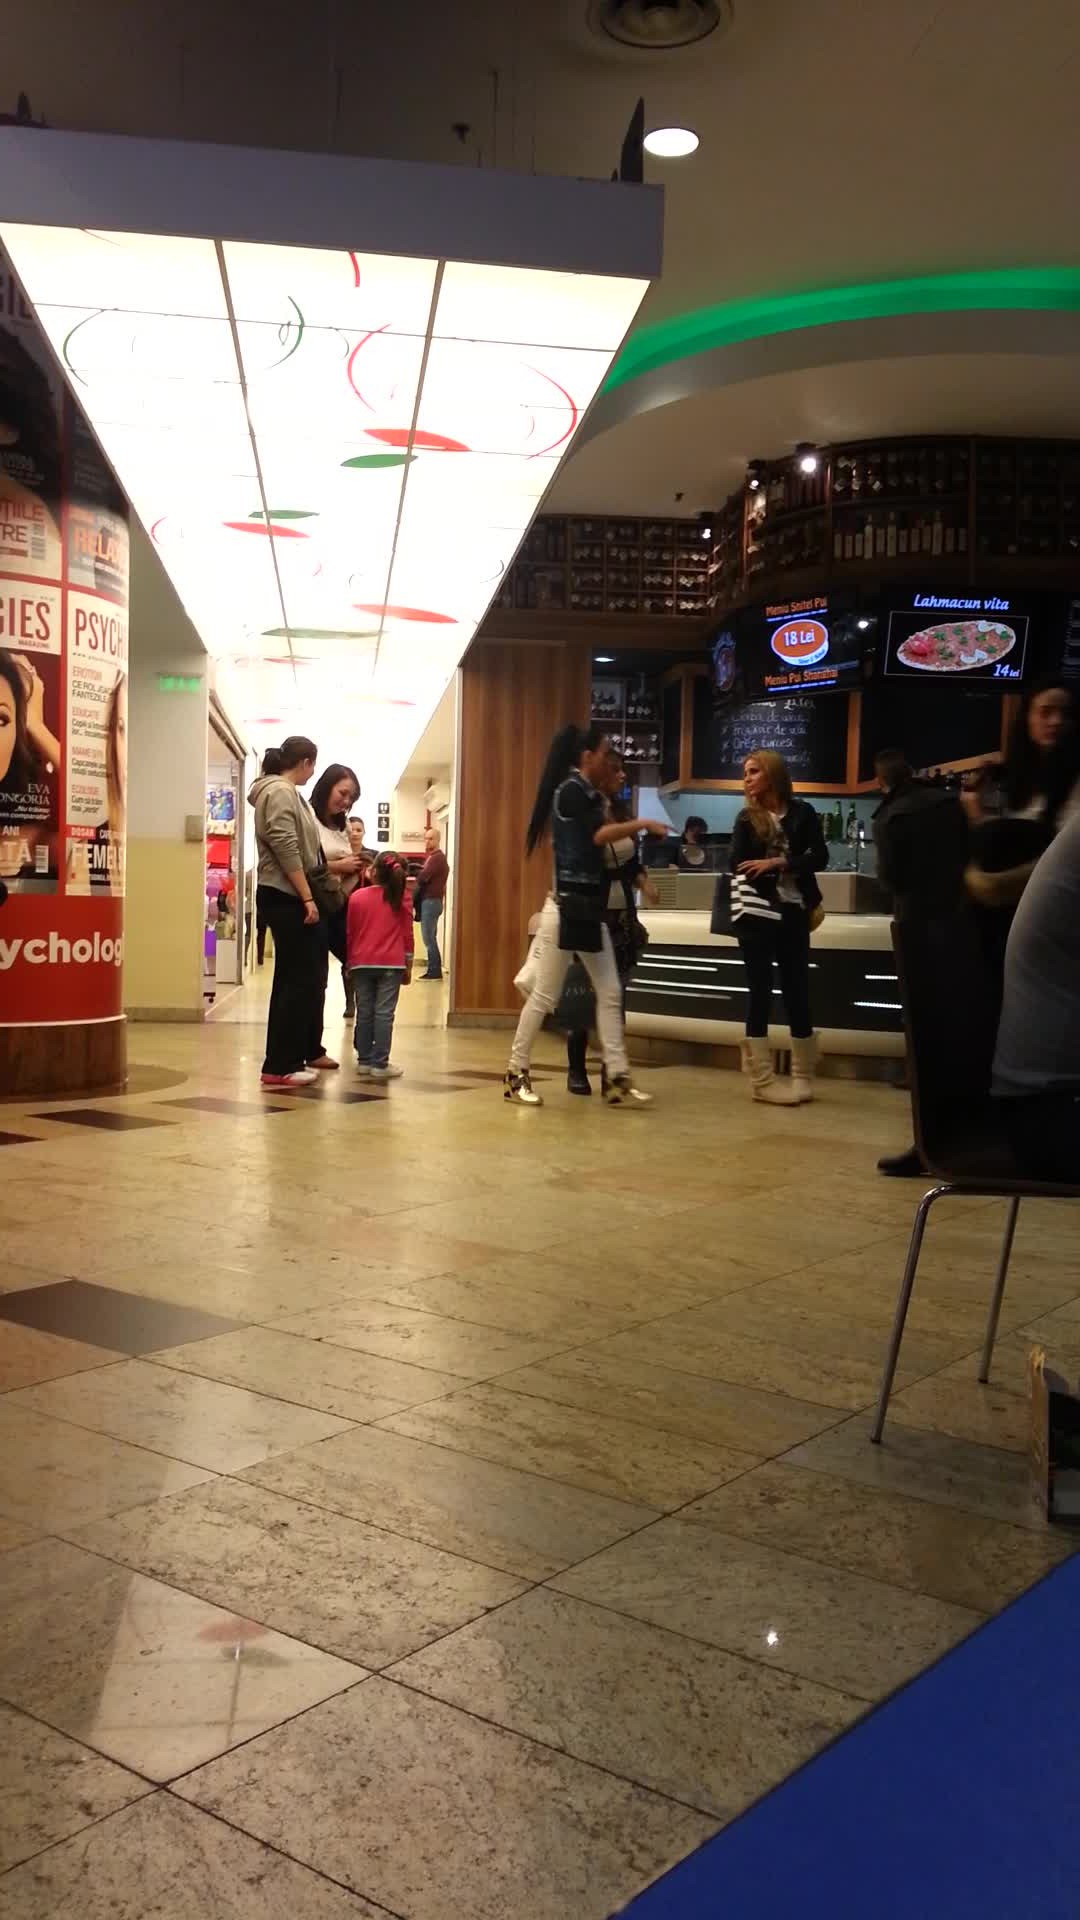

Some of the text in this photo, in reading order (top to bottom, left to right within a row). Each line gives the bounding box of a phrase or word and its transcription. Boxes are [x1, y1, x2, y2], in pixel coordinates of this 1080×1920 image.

[914, 594, 1010, 610] Lahmacun vita
[784, 628, 816, 647] 18 Lei
[993, 663, 1010, 677] 14
[789, 671, 802, 684] Pui
[28, 783, 50, 795] EVA
[2, 825, 20, 836] ANI
